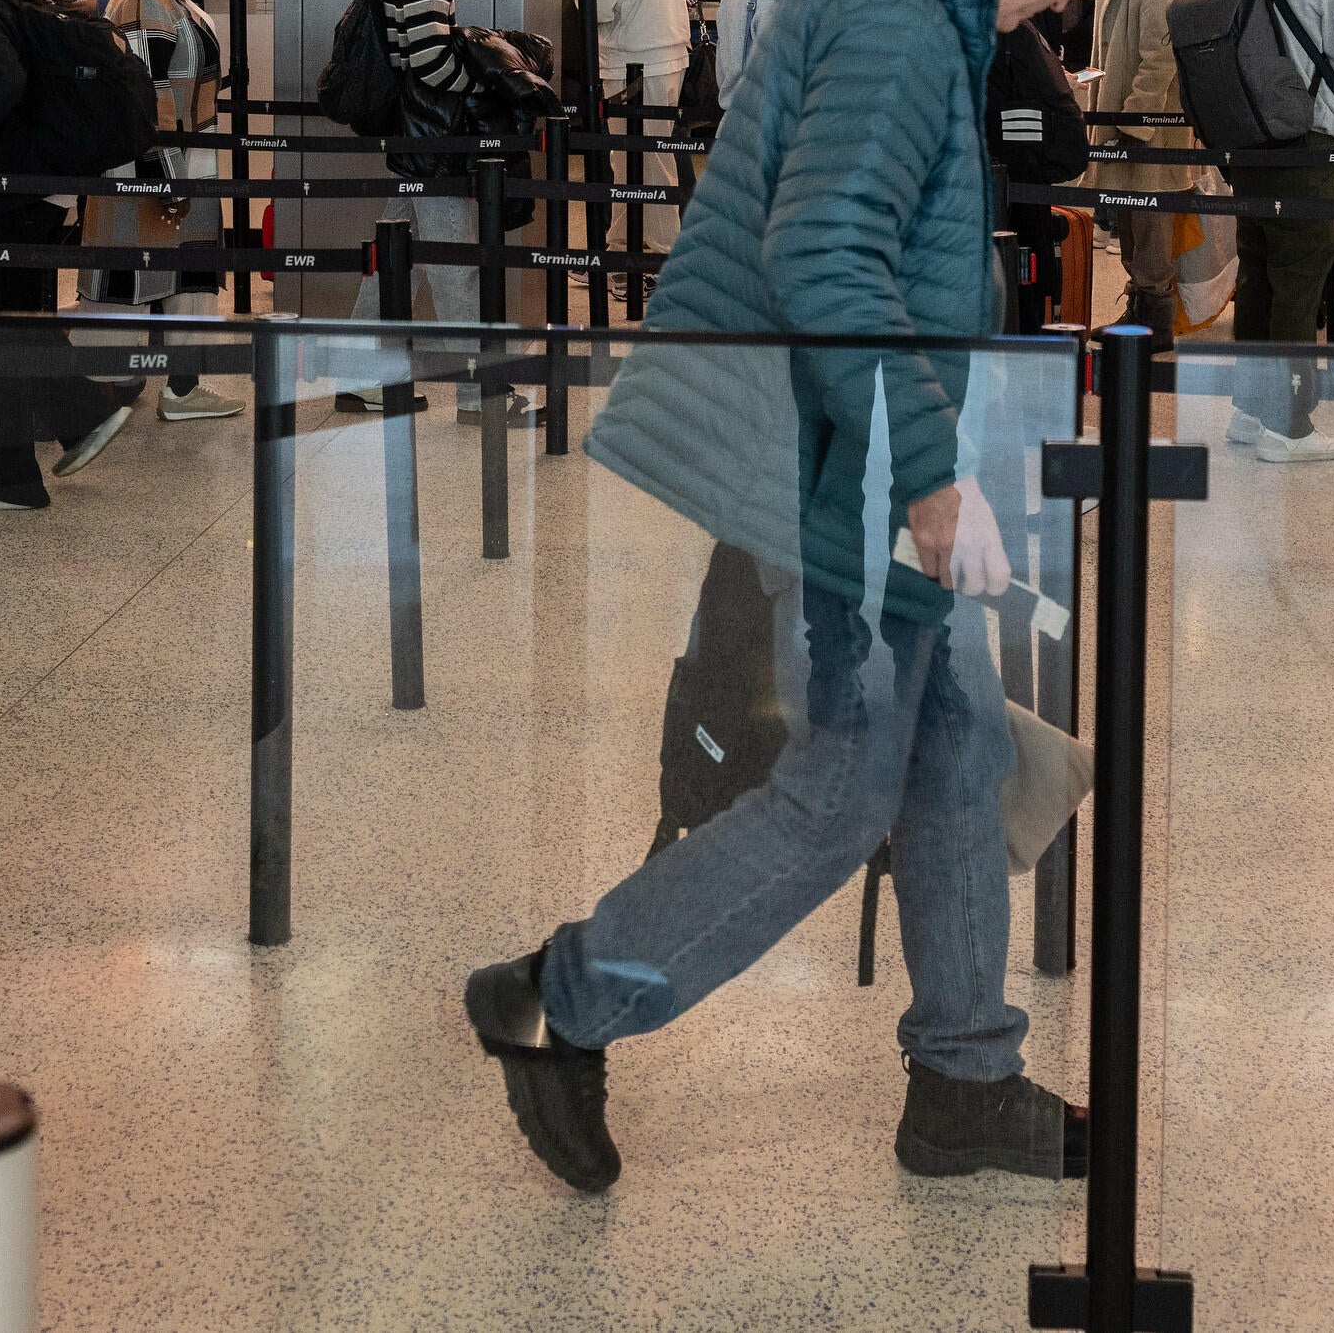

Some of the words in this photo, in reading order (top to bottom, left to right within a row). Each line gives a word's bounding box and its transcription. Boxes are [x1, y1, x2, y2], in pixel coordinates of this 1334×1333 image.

[1142, 116, 1178, 124] Terminal
[240, 138, 279, 148] Terminal
[280, 139, 287, 148] A
[479, 139, 501, 148] EWR
[657, 141, 697, 150] Terminal
[1089, 150, 1119, 159] rminal
[1120, 151, 1128, 159] A
[116, 183, 162, 193] Terminal
[163, 185, 172, 193] A
[399, 183, 424, 193] EWR
[610, 189, 657, 199] Terminal
[658, 191, 667, 199] A
[1099, 194, 1148, 206] Terminal
[1148, 196, 1158, 207] A
[0, 249, 10, 261] A
[531, 253, 588, 265] Terminal
[589, 254, 601, 266] A
[285, 255, 315, 266] EWR
[129, 354, 167, 368] EWR
